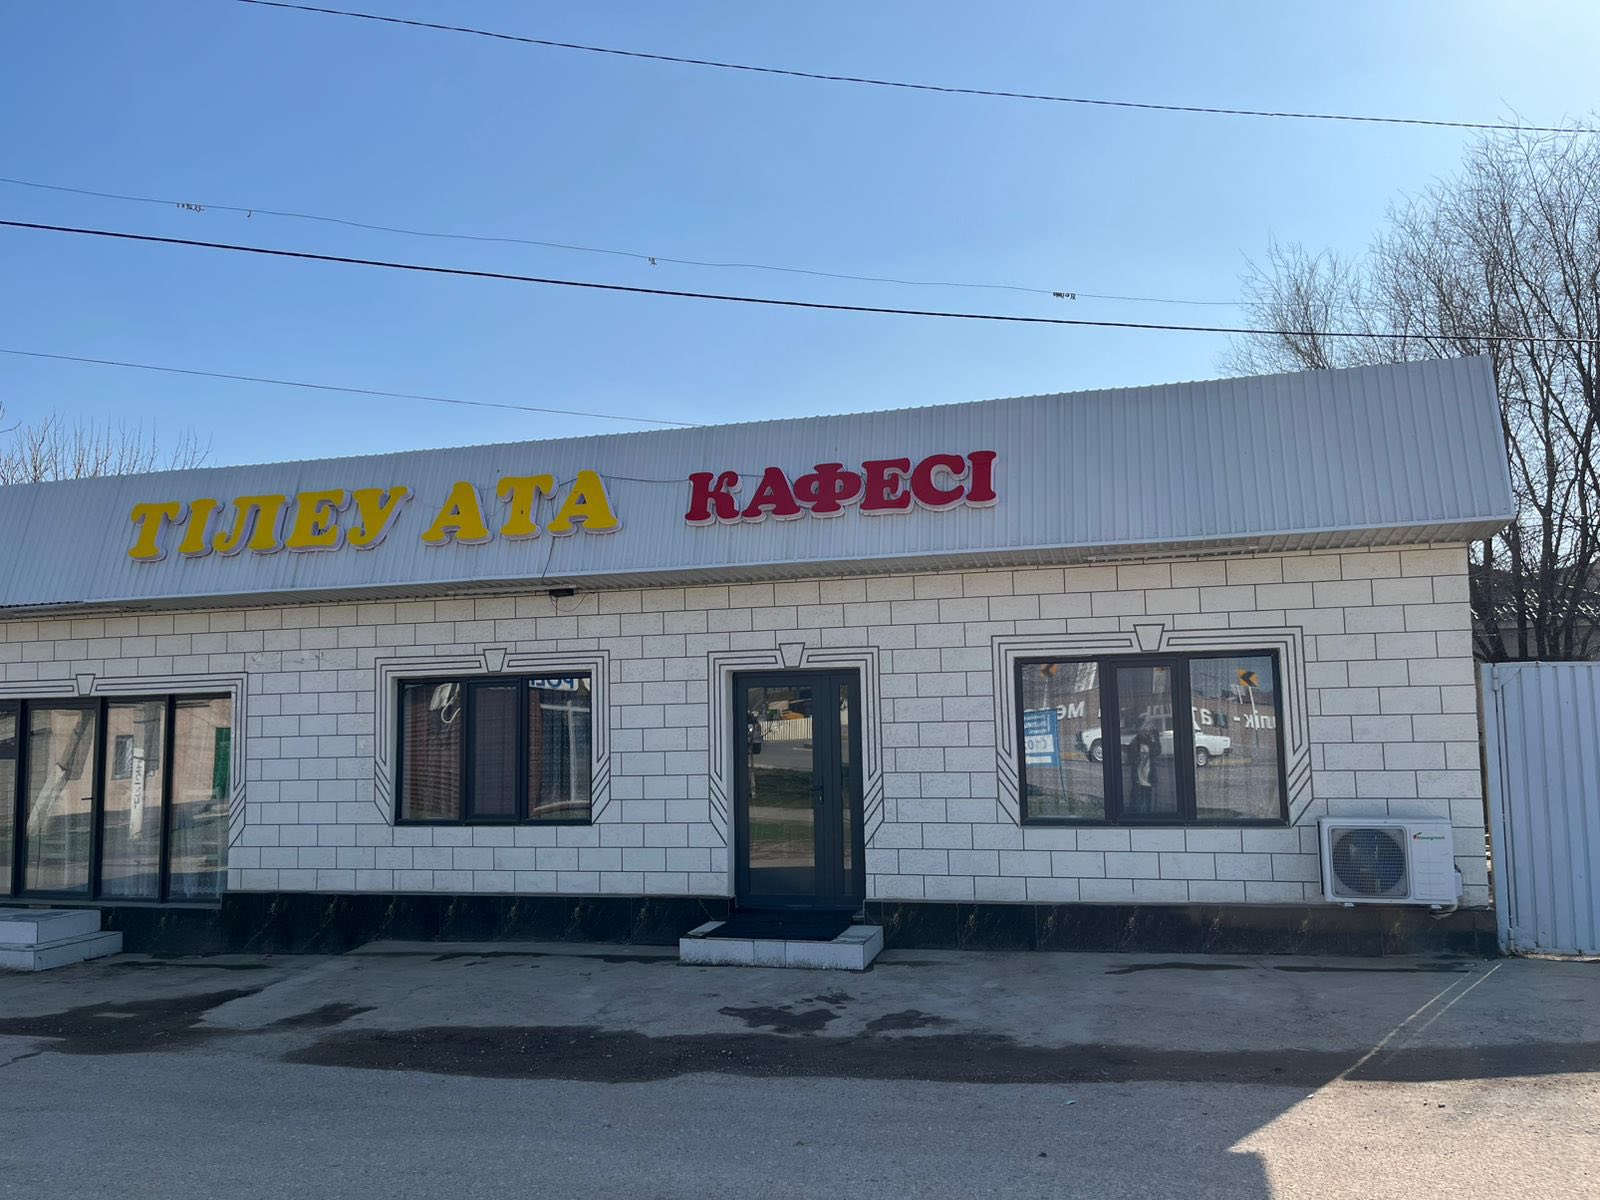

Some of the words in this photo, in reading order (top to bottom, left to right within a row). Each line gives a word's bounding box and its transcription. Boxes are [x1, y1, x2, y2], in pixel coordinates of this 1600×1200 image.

[128, 487, 413, 561] ТІЛЕУ
[421, 470, 622, 545] АТА
[685, 450, 998, 525] КАФЕСІ
